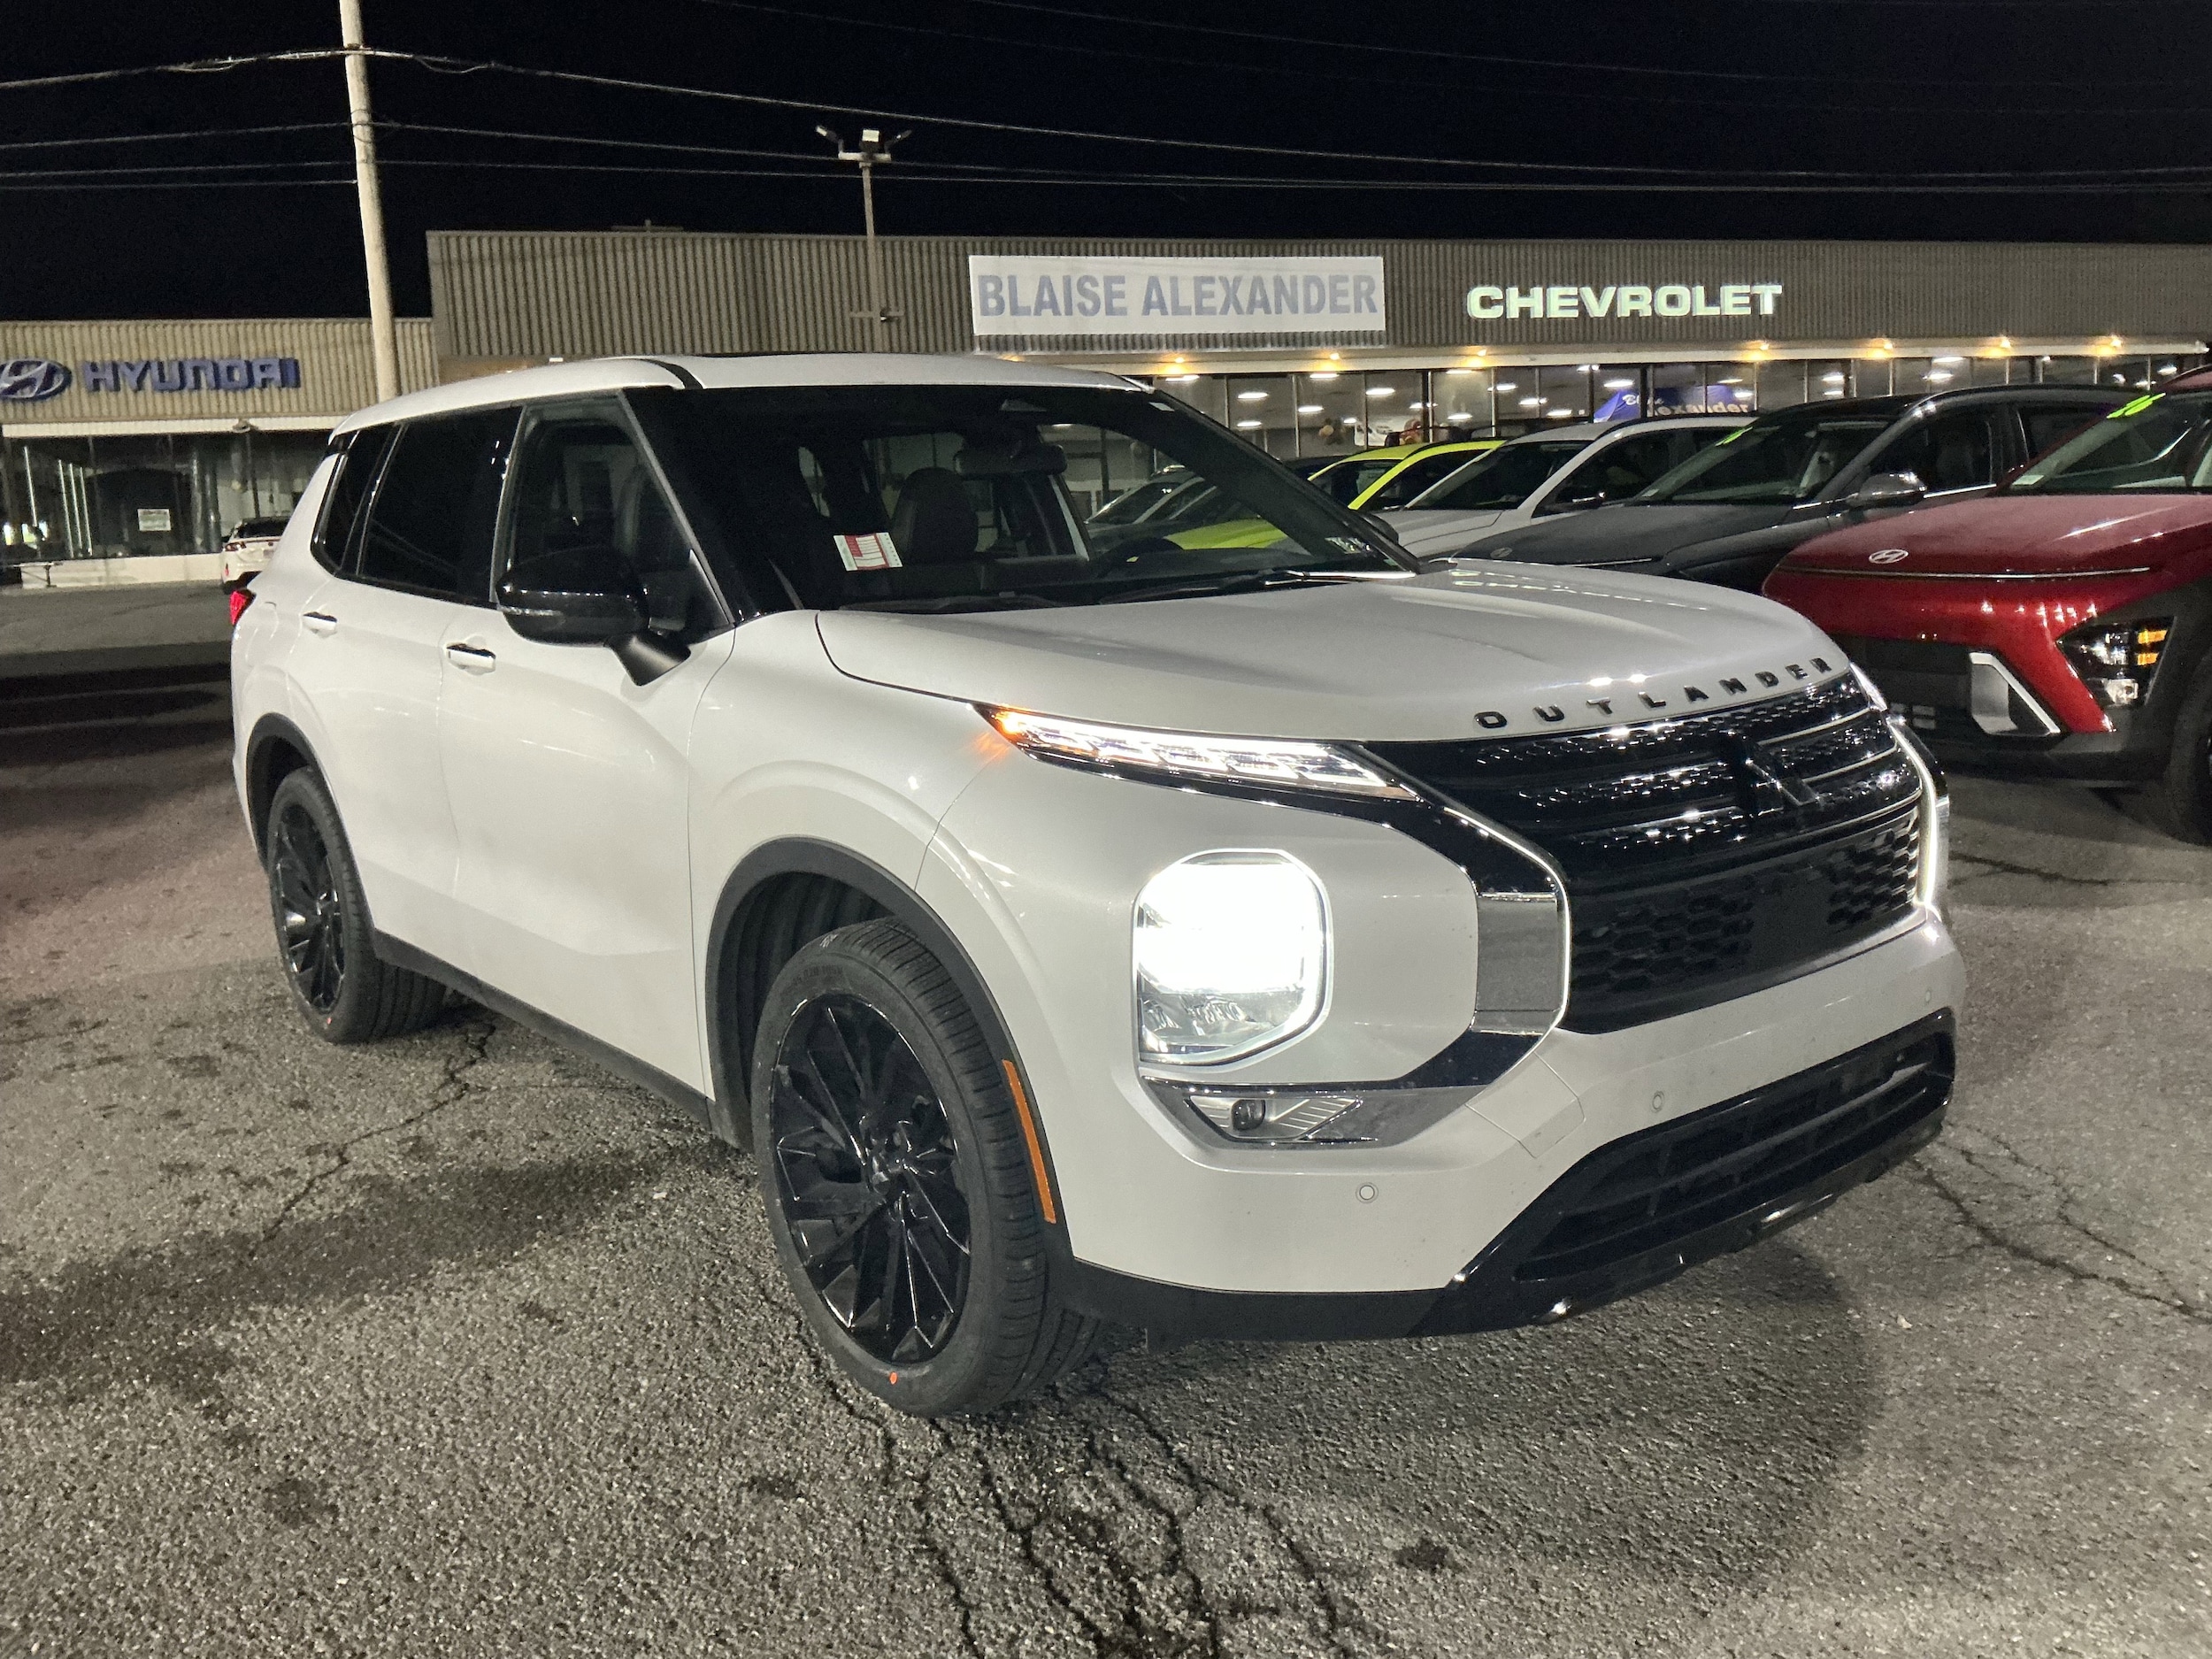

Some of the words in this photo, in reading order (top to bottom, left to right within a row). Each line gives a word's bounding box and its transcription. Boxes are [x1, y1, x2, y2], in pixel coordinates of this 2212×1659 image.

[978, 274, 1128, 317] BLAISE
[1142, 274, 1379, 316] ALEXANDER
[1466, 284, 1783, 319] CHEVROLET
[83, 357, 301, 392] HYUNDAI
[1473, 657, 1832, 729] OUTLANDER
